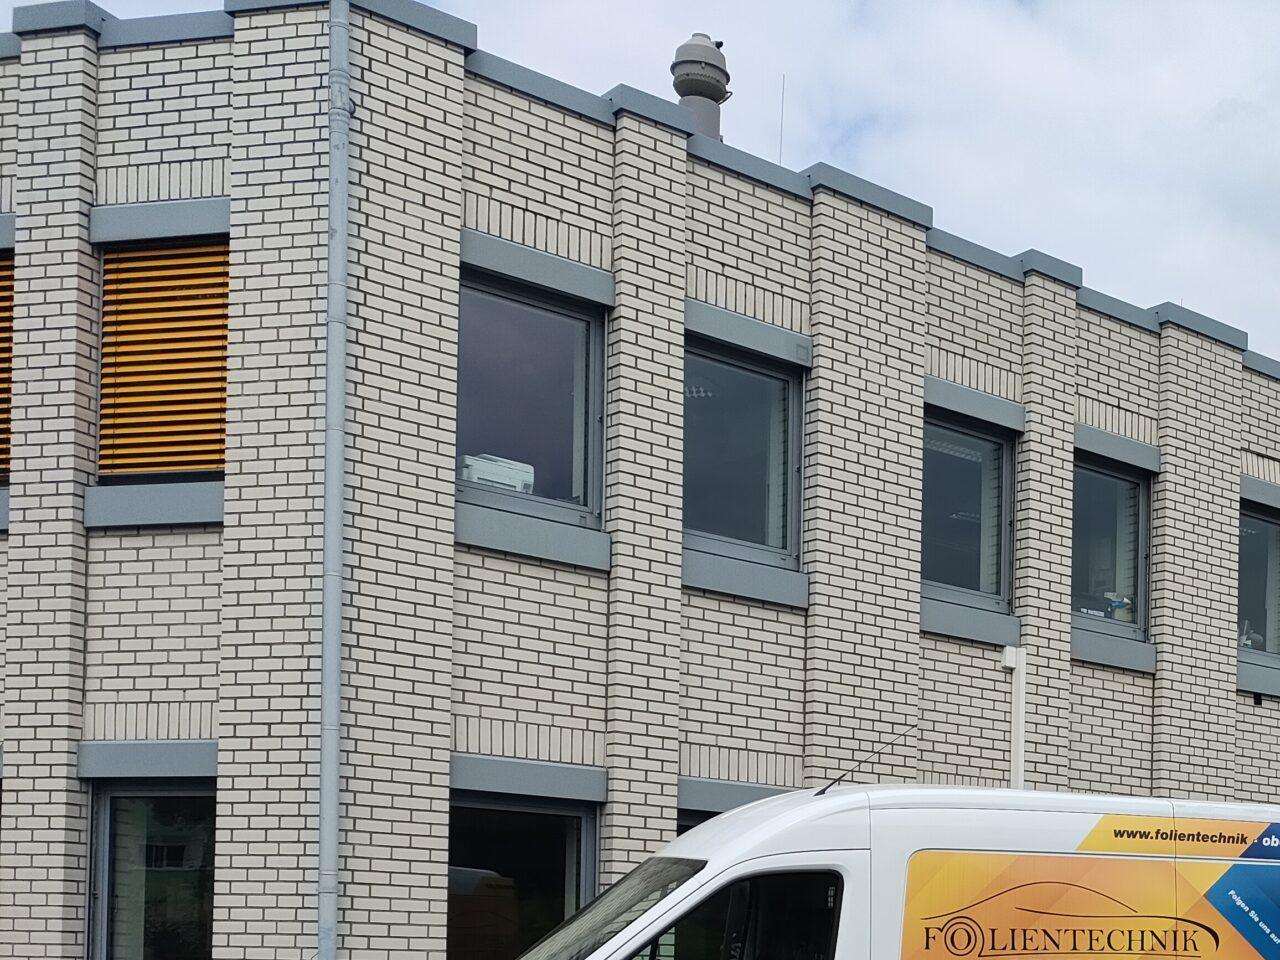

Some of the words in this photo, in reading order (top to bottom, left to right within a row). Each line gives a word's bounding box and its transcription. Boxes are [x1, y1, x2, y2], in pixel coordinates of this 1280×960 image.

[1113, 828, 1248, 845] www.folientechnik
[1227, 889, 1250, 913] Folgen
[1248, 909, 1260, 923] Sie
[1258, 921, 1271, 935] uns
[924, 923, 1199, 953] FOLIENTECHNIK
